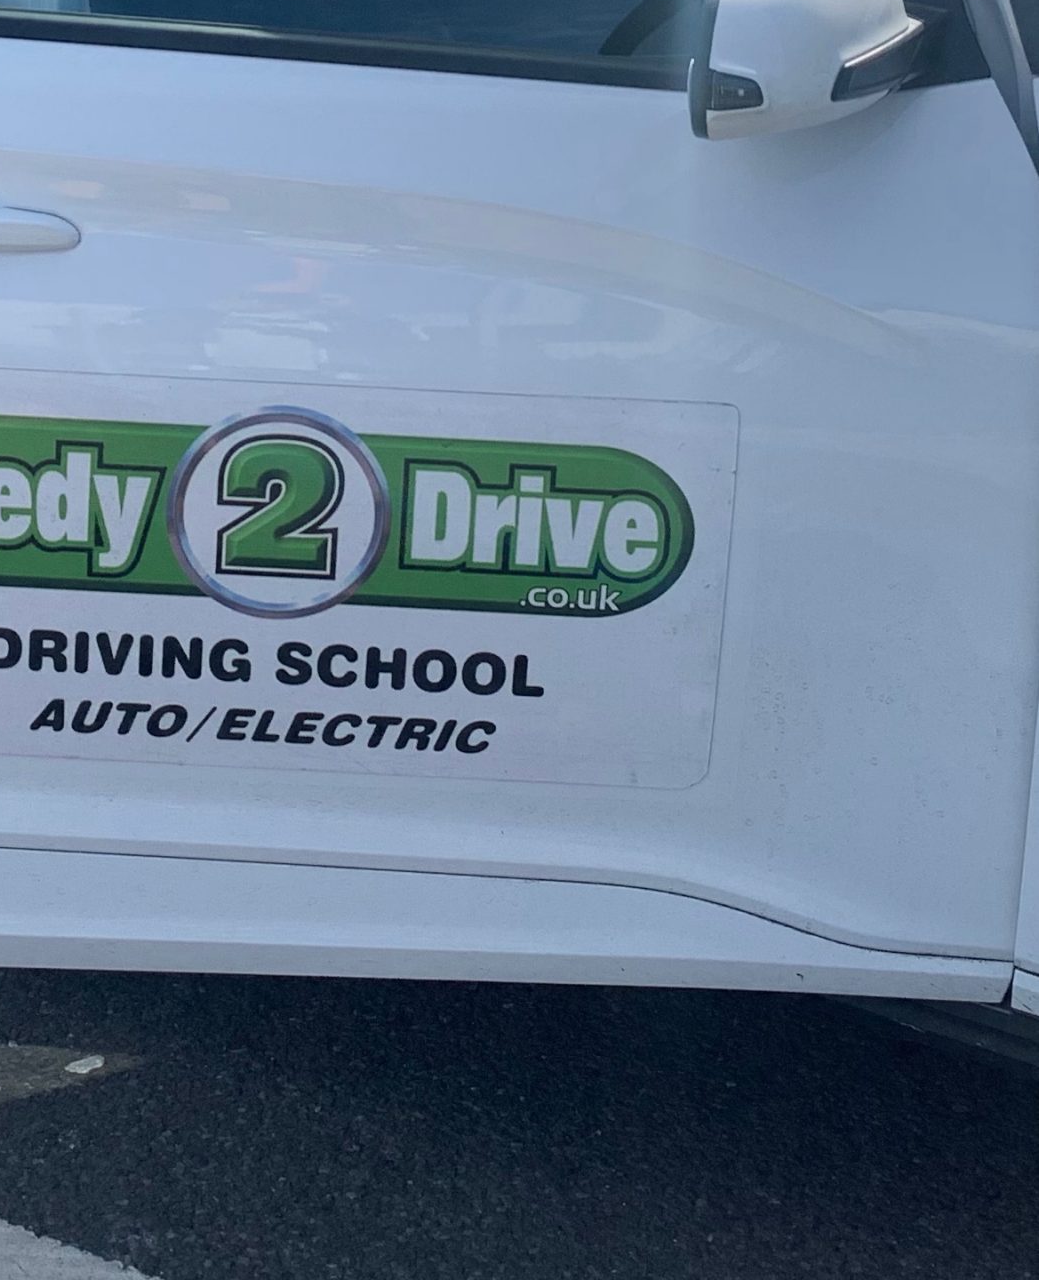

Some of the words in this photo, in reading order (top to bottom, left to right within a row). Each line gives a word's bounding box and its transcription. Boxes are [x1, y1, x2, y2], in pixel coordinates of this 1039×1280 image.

[215, 433, 345, 581] 2
[409, 468, 661, 574] Drive
[519, 583, 622, 613] .co.uk
[274, 641, 545, 698] SCHOOL
[29, 698, 498, 754] AUTO/ELECTRIC
